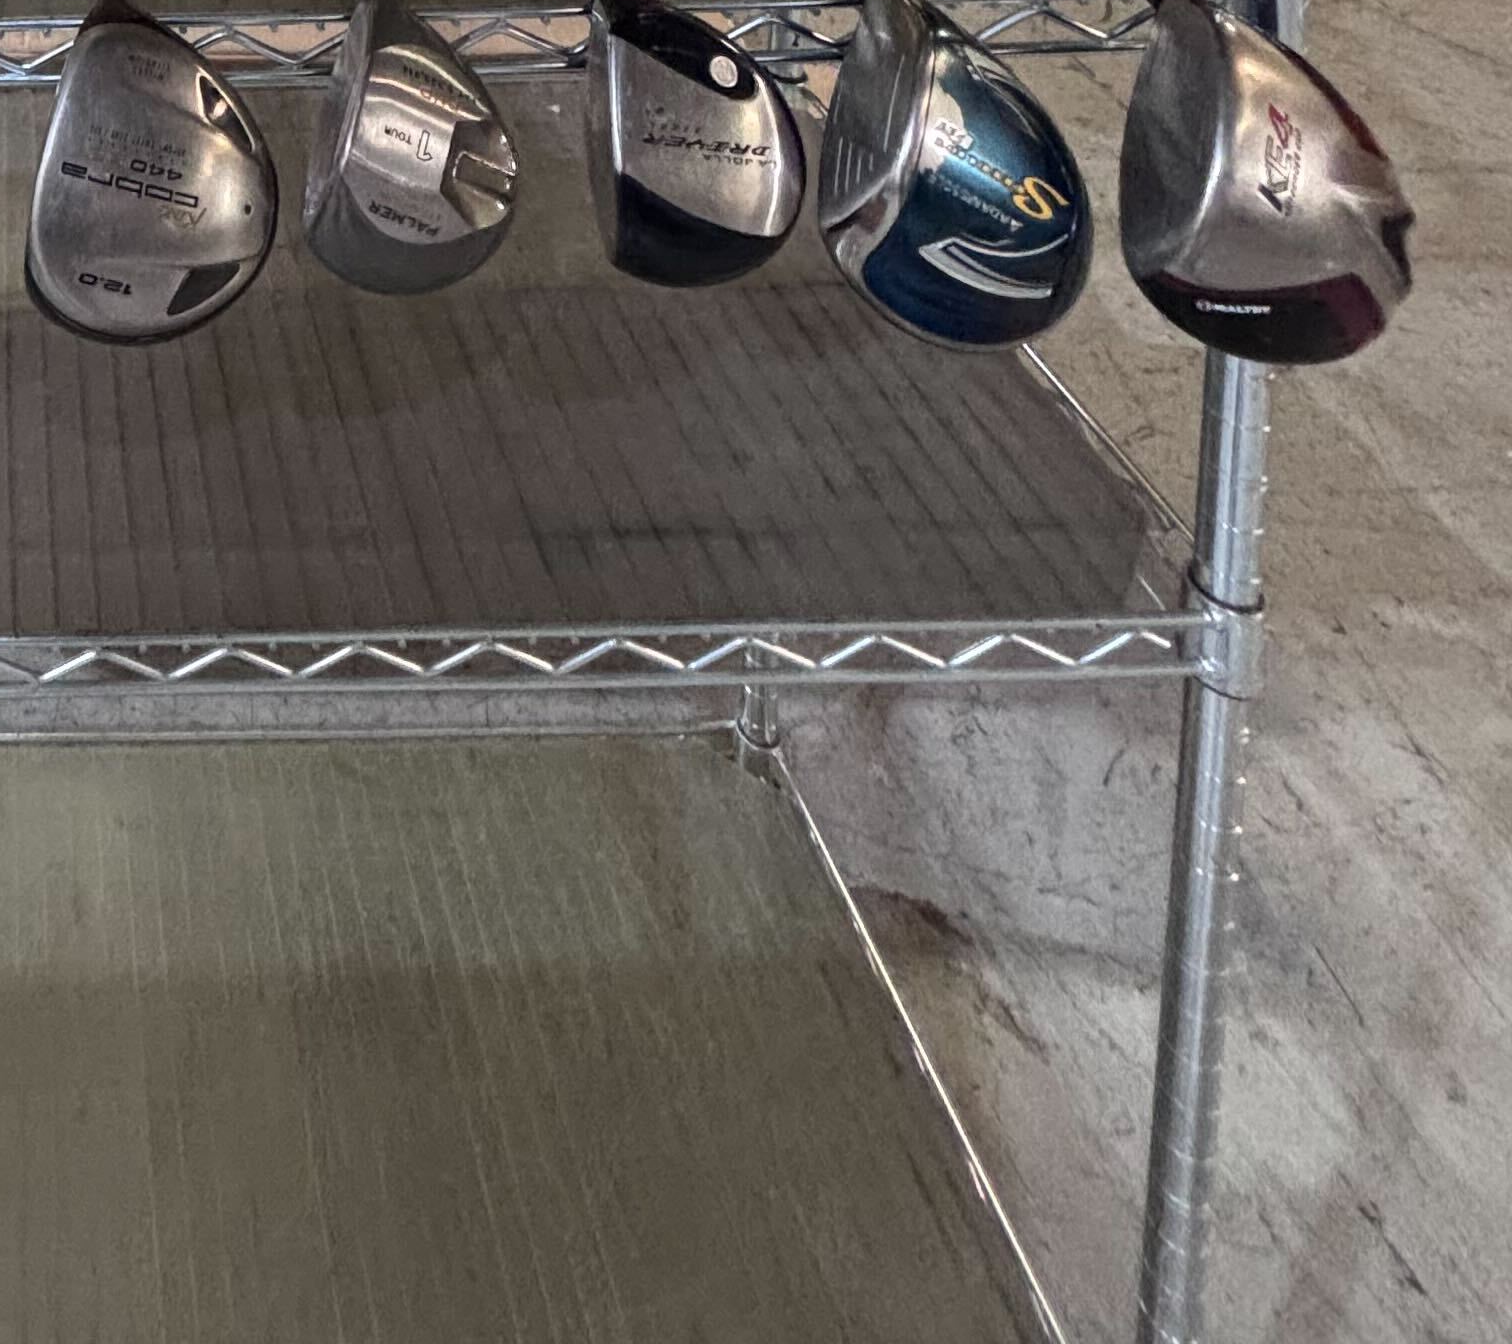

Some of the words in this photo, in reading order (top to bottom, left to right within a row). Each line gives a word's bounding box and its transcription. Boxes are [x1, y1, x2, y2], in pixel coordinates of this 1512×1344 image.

[384, 123, 414, 146] TOUR
[642, 132, 772, 157] DRIVER
[130, 158, 184, 181] 440
[61, 161, 200, 209] cobra
[368, 198, 439, 238] PALMER
[78, 272, 133, 296] 12.0
